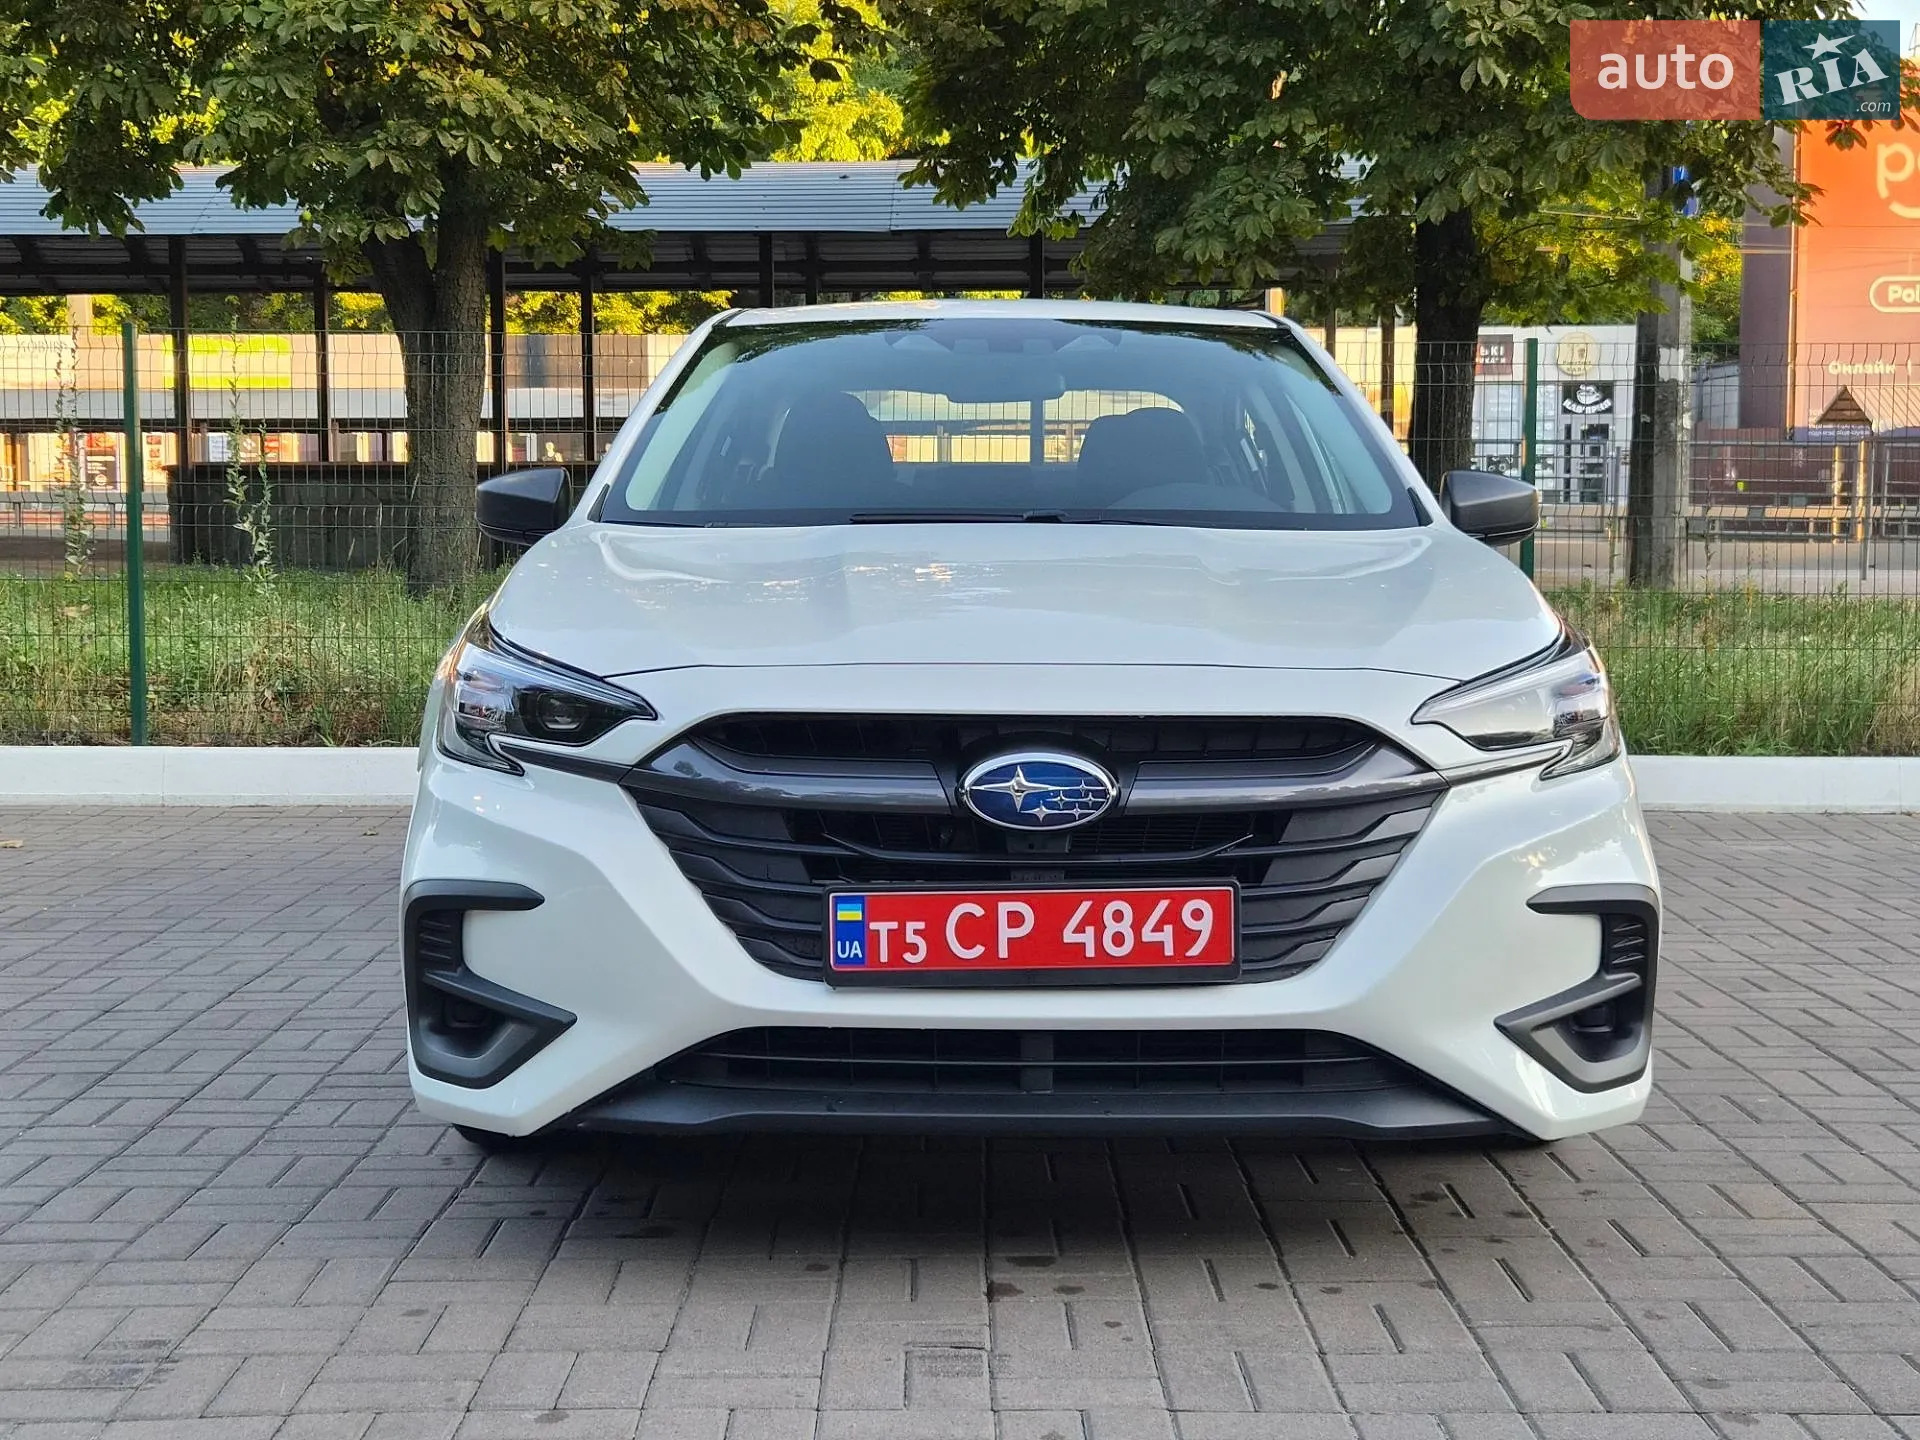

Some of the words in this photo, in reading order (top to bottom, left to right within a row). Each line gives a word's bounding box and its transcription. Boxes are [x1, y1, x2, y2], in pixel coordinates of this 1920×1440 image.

[1828, 359, 1896, 375] Онлайн
[869, 921, 928, 964] T5
[945, 901, 1035, 960] CP
[1063, 899, 1213, 959] 4849
[836, 940, 863, 960] UA
